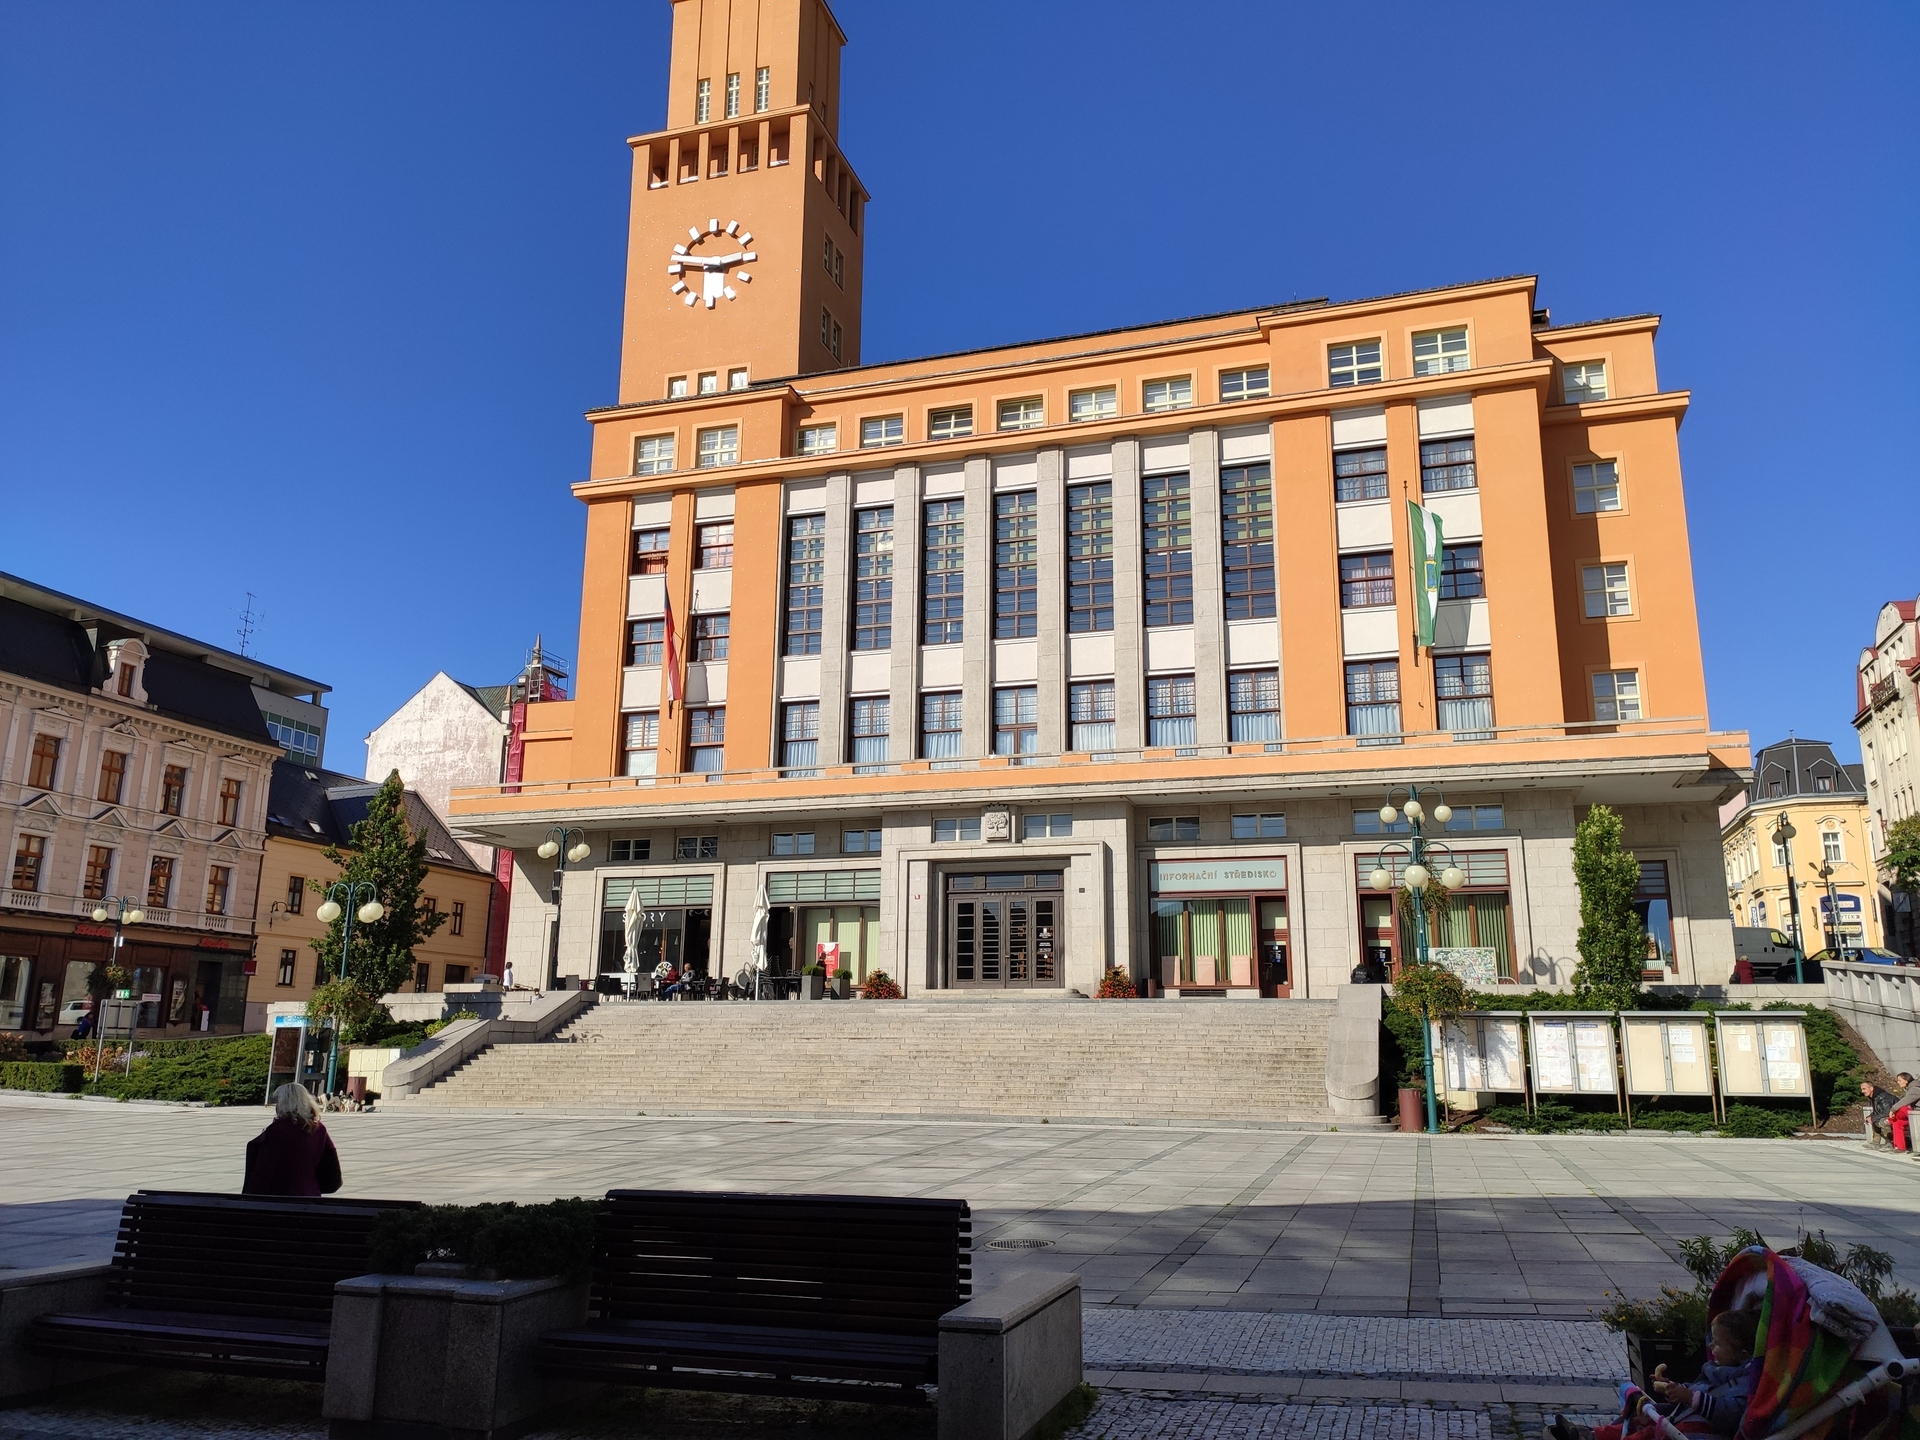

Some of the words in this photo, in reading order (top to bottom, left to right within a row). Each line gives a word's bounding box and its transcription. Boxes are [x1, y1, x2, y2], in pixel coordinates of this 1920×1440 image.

[1160, 871, 1217, 881] INFORMAČNÍ
[1224, 870, 1277, 879] STŘEDISKO
[622, 912, 666, 922] SORY
